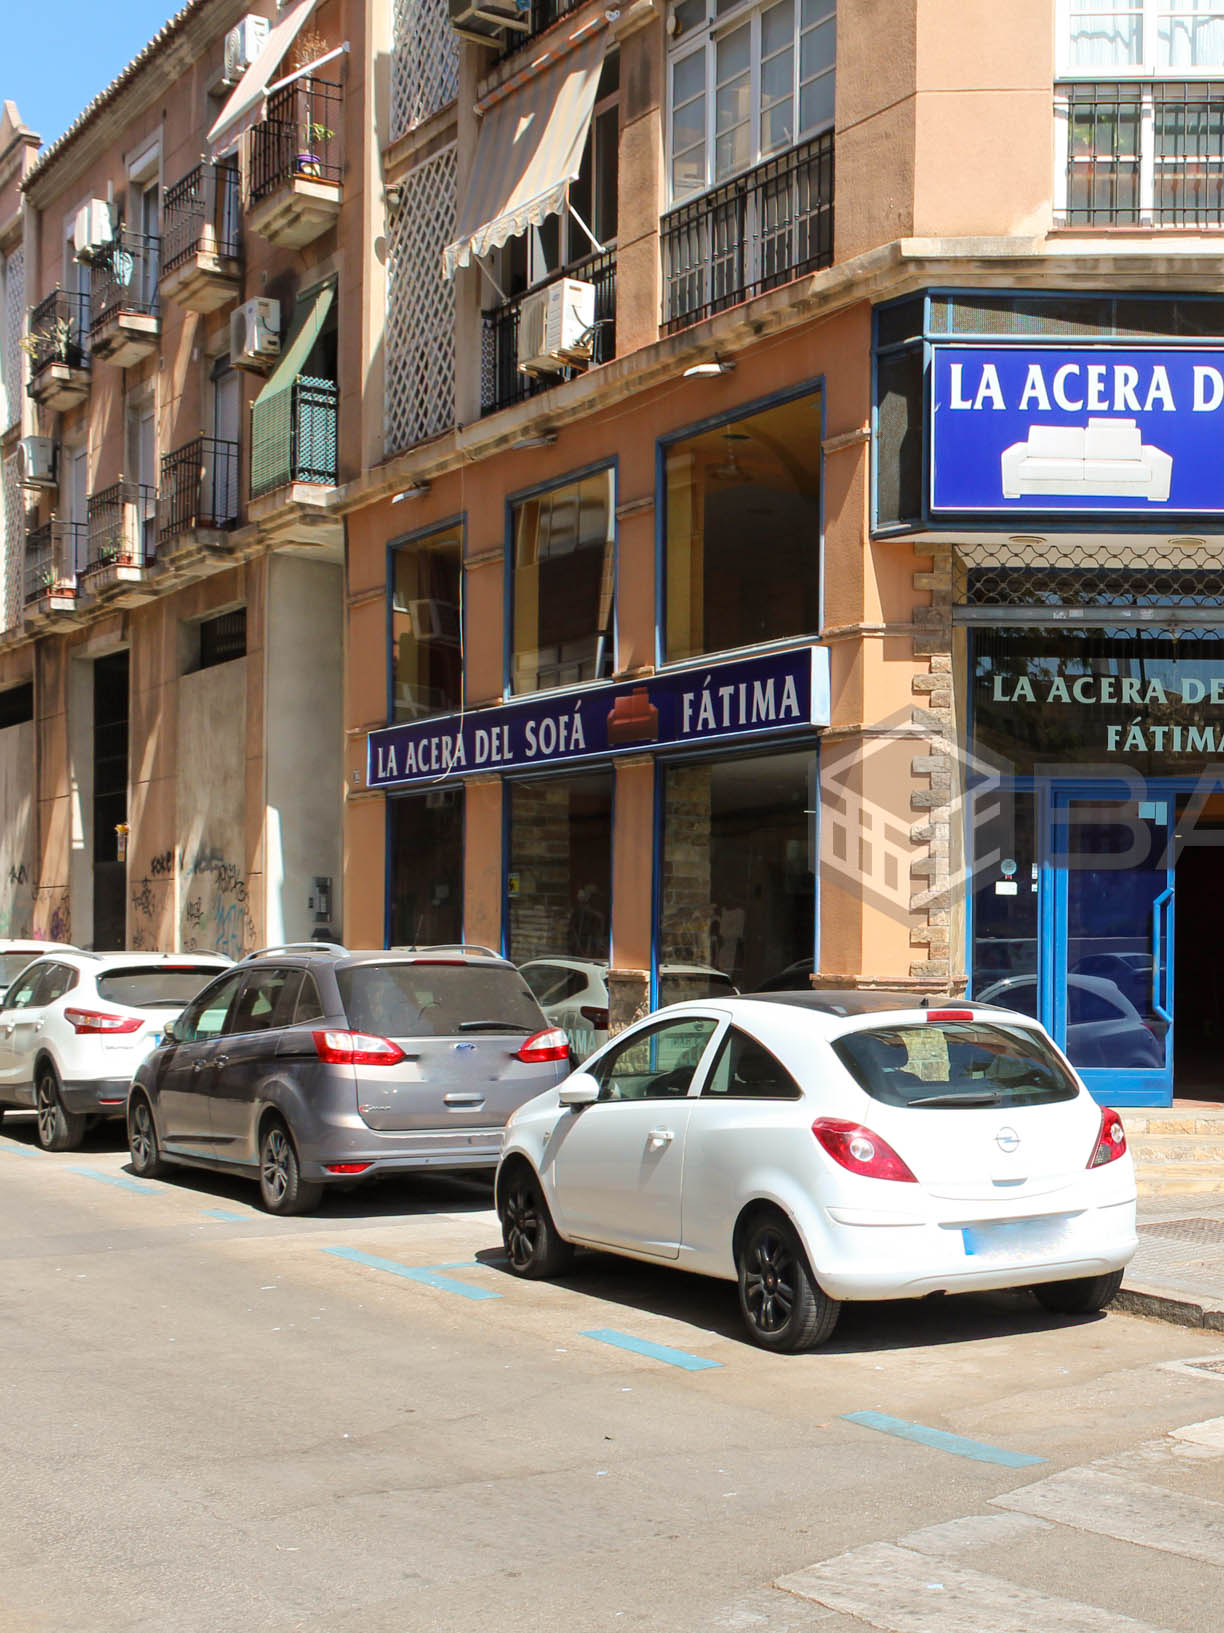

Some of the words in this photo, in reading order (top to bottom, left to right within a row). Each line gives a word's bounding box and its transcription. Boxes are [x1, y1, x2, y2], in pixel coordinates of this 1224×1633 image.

[949, 363, 1006, 410] LA
[1018, 364, 1176, 412] ACERA
[682, 674, 801, 733] FÁTIMA
[993, 675, 1035, 702] LA
[1046, 677, 1169, 704] ACERA
[377, 744, 398, 778] LA
[405, 733, 467, 774] ACERA
[475, 725, 513, 764] DEL
[525, 700, 586, 757] SOFÁ
